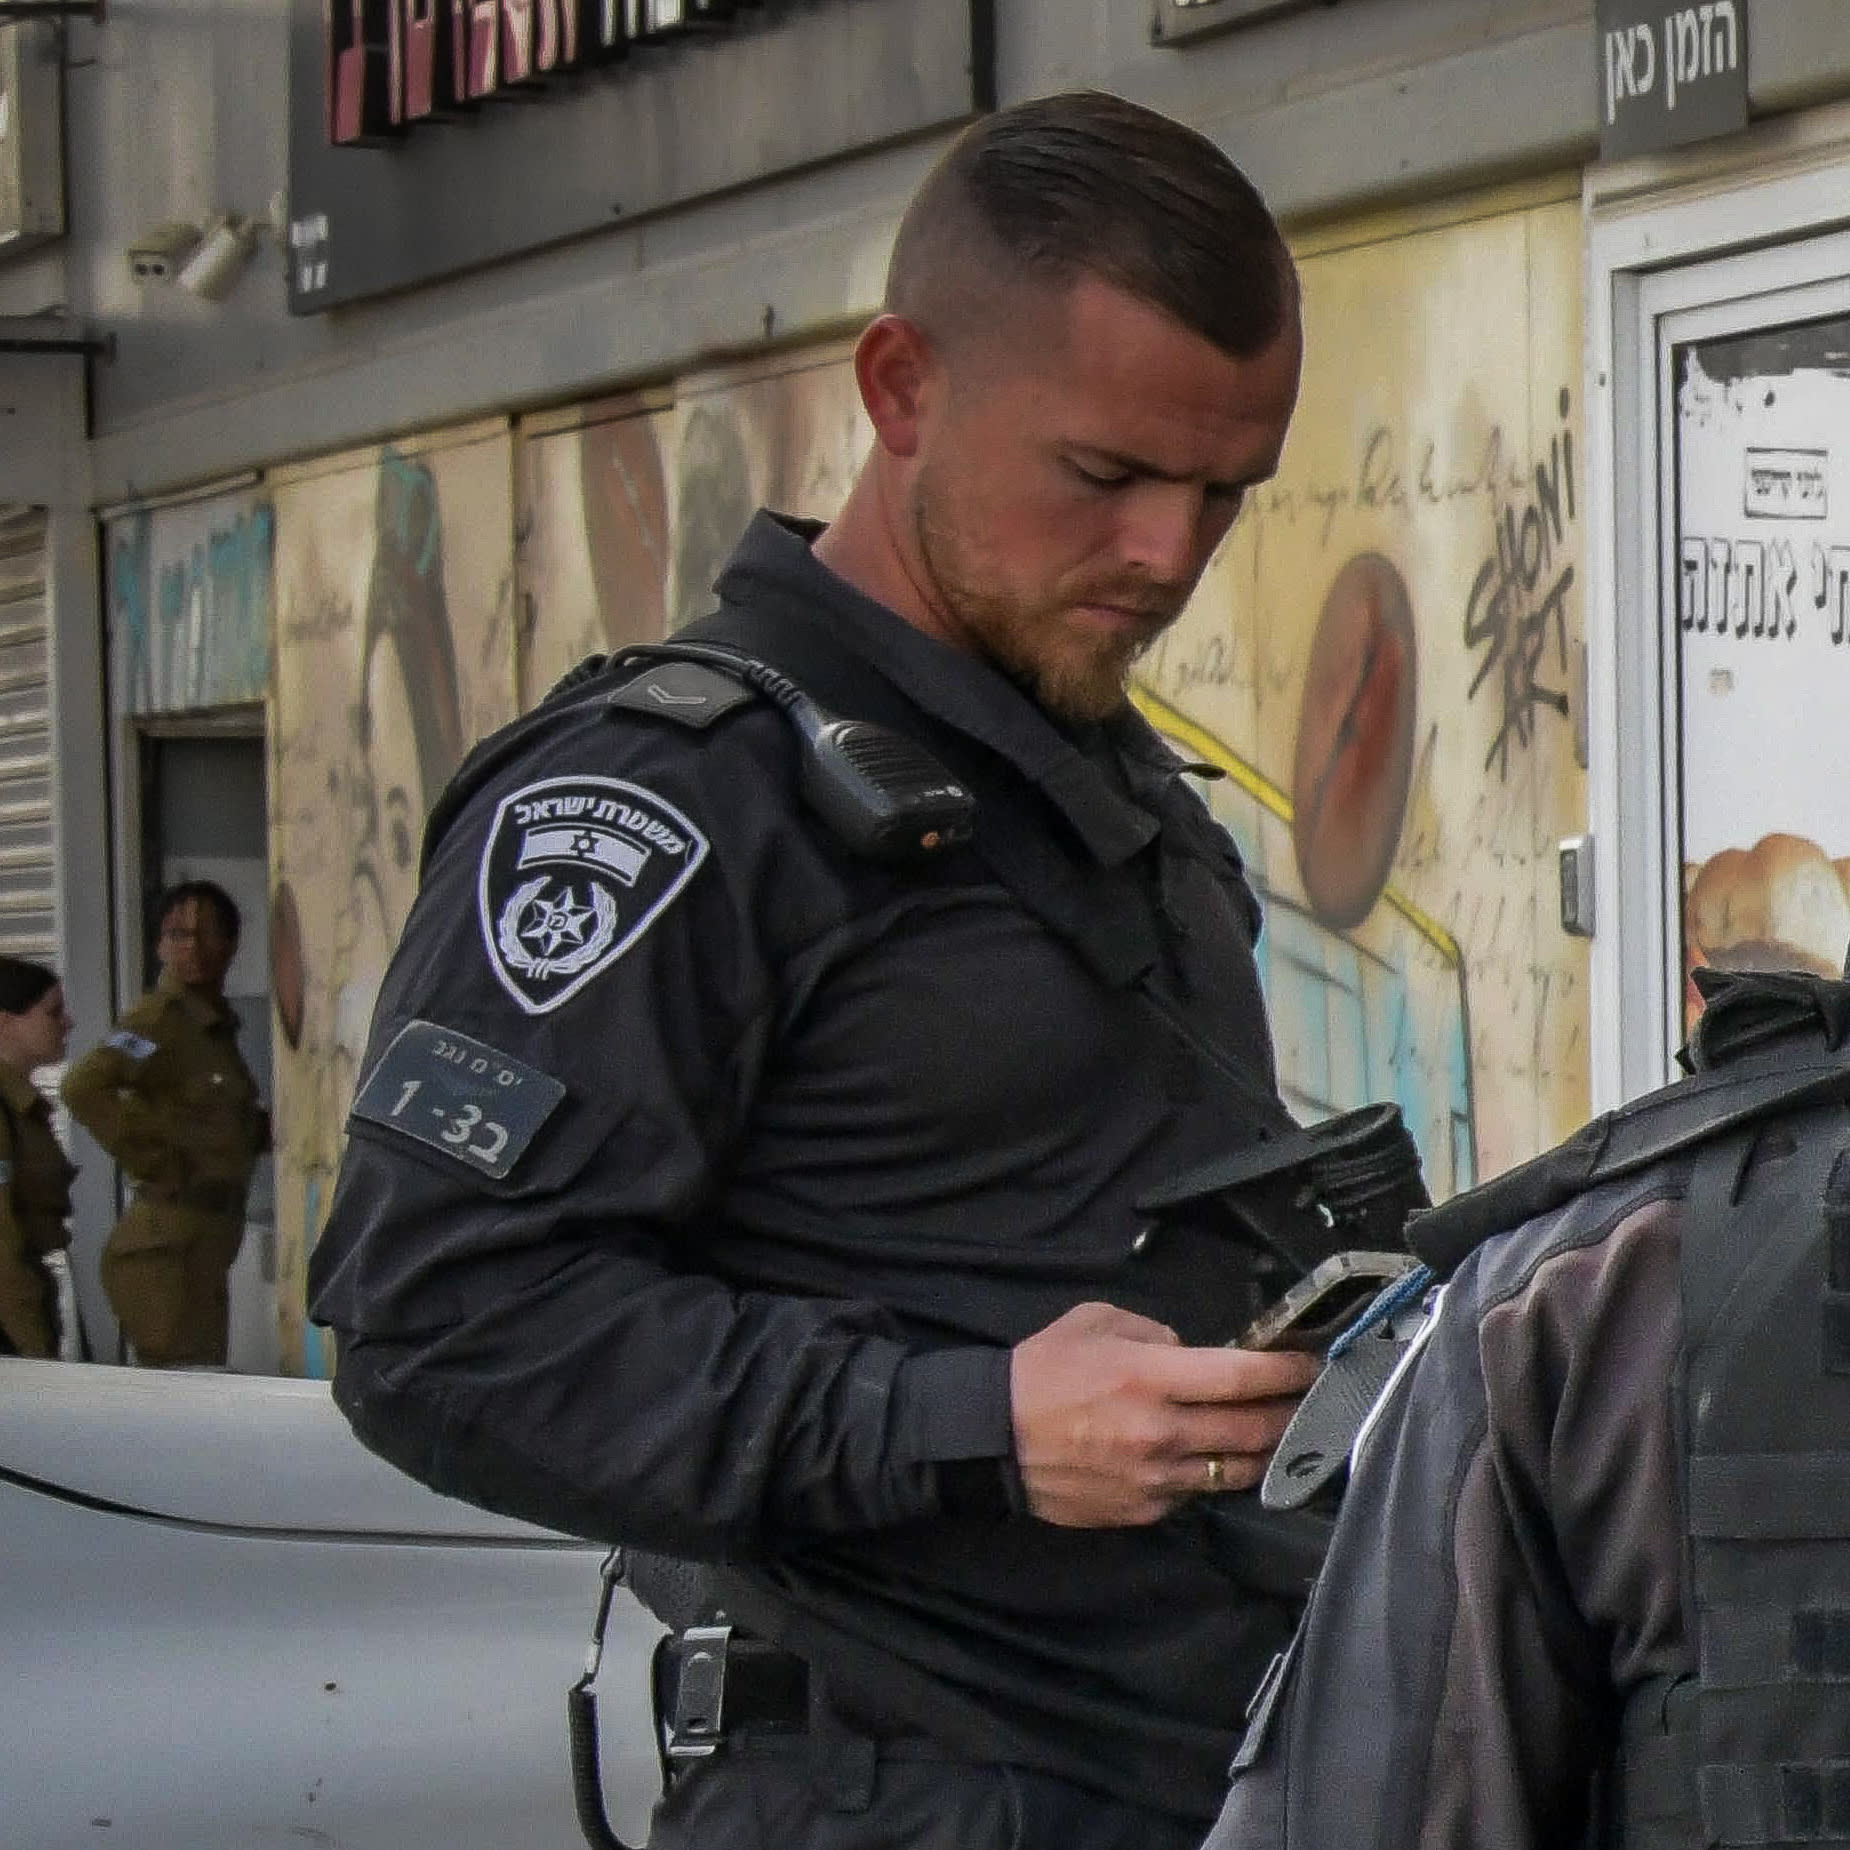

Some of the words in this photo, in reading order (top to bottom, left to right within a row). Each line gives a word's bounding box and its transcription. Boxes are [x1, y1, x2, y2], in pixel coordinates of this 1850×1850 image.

[1605, 23, 1655, 126] כאן
[1664, 0, 1738, 111] הזמן
[514, 795, 597, 825] ישראל
[592, 799, 687, 856] משטרת
